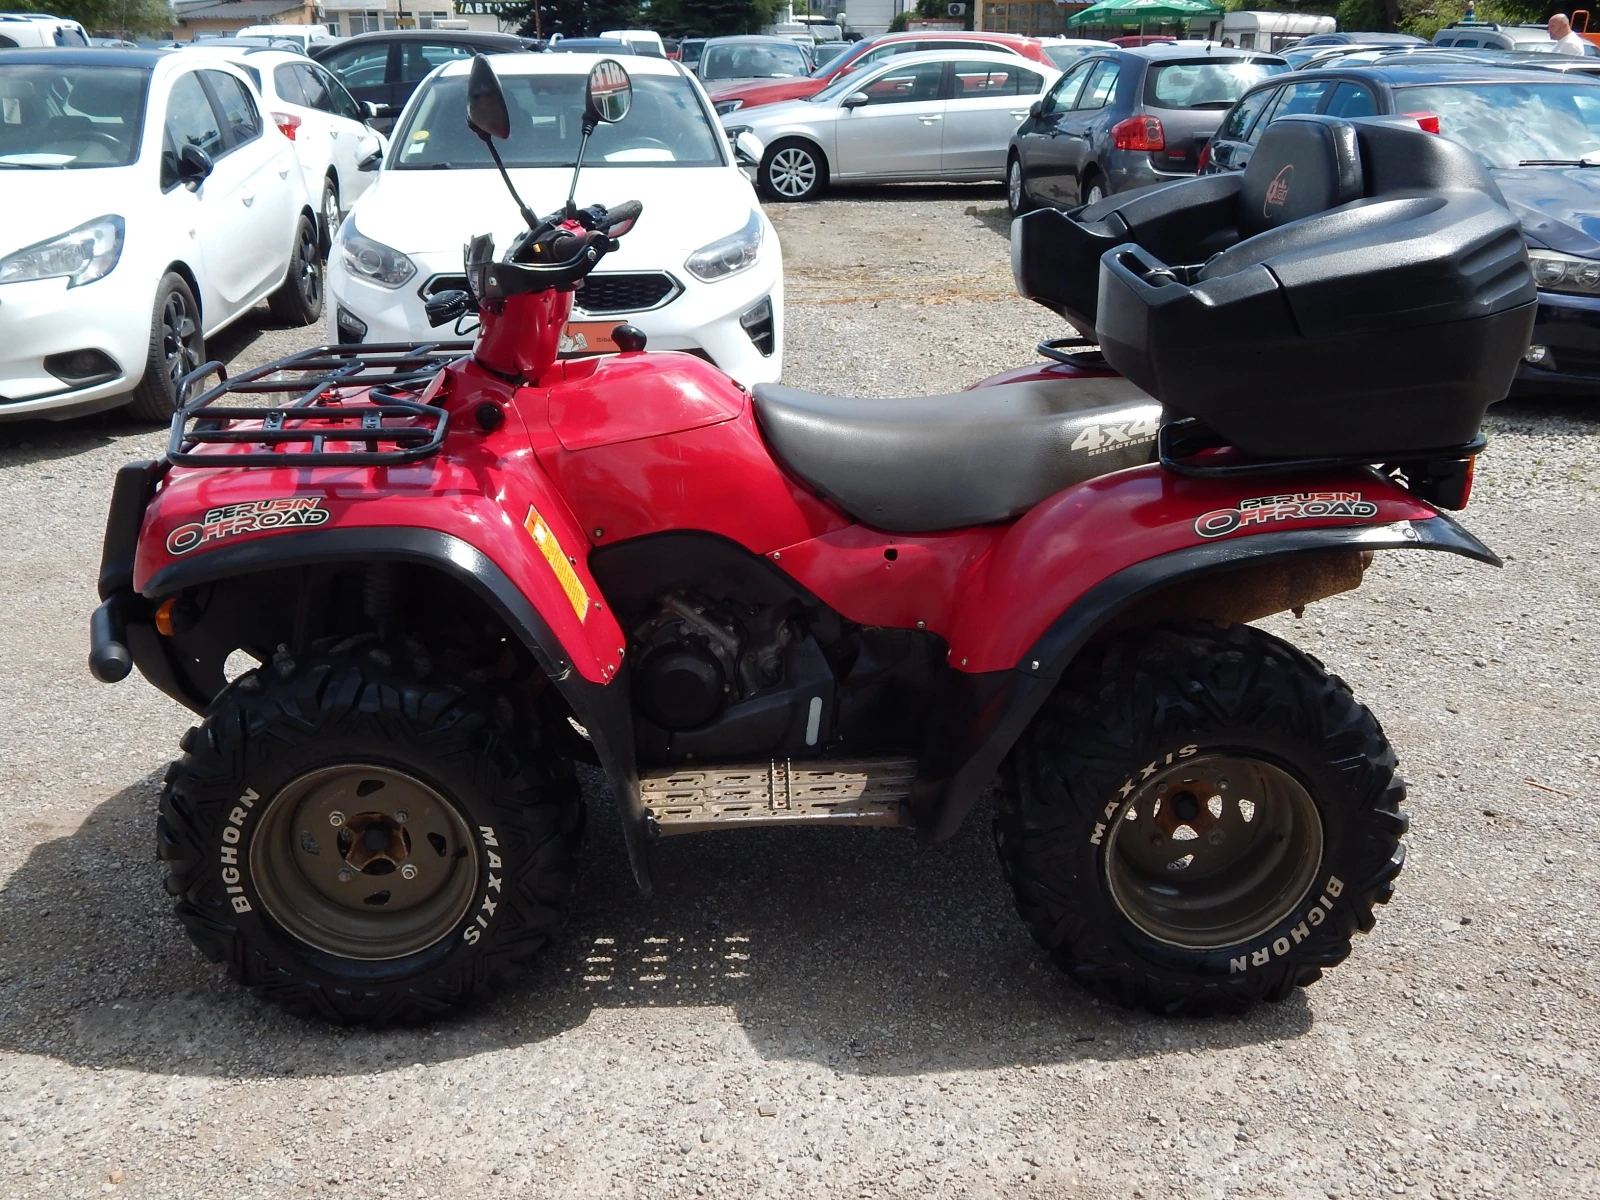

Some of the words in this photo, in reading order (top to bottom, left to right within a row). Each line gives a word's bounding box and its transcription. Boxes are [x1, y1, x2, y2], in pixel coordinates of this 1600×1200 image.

[1088, 434, 1158, 457] SELECTABLE
[206, 497, 322, 525] PERUSIN
[1194, 502, 1377, 537] OFFROAD
[1240, 491, 1360, 510] PERUSIN
[167, 510, 330, 554] OFFROAD
[1090, 744, 1198, 845] MAXXIS
[221, 787, 260, 913] BIGHORN
[464, 826, 502, 945] MAXXIS
[1230, 875, 1344, 974] BIGHORN
